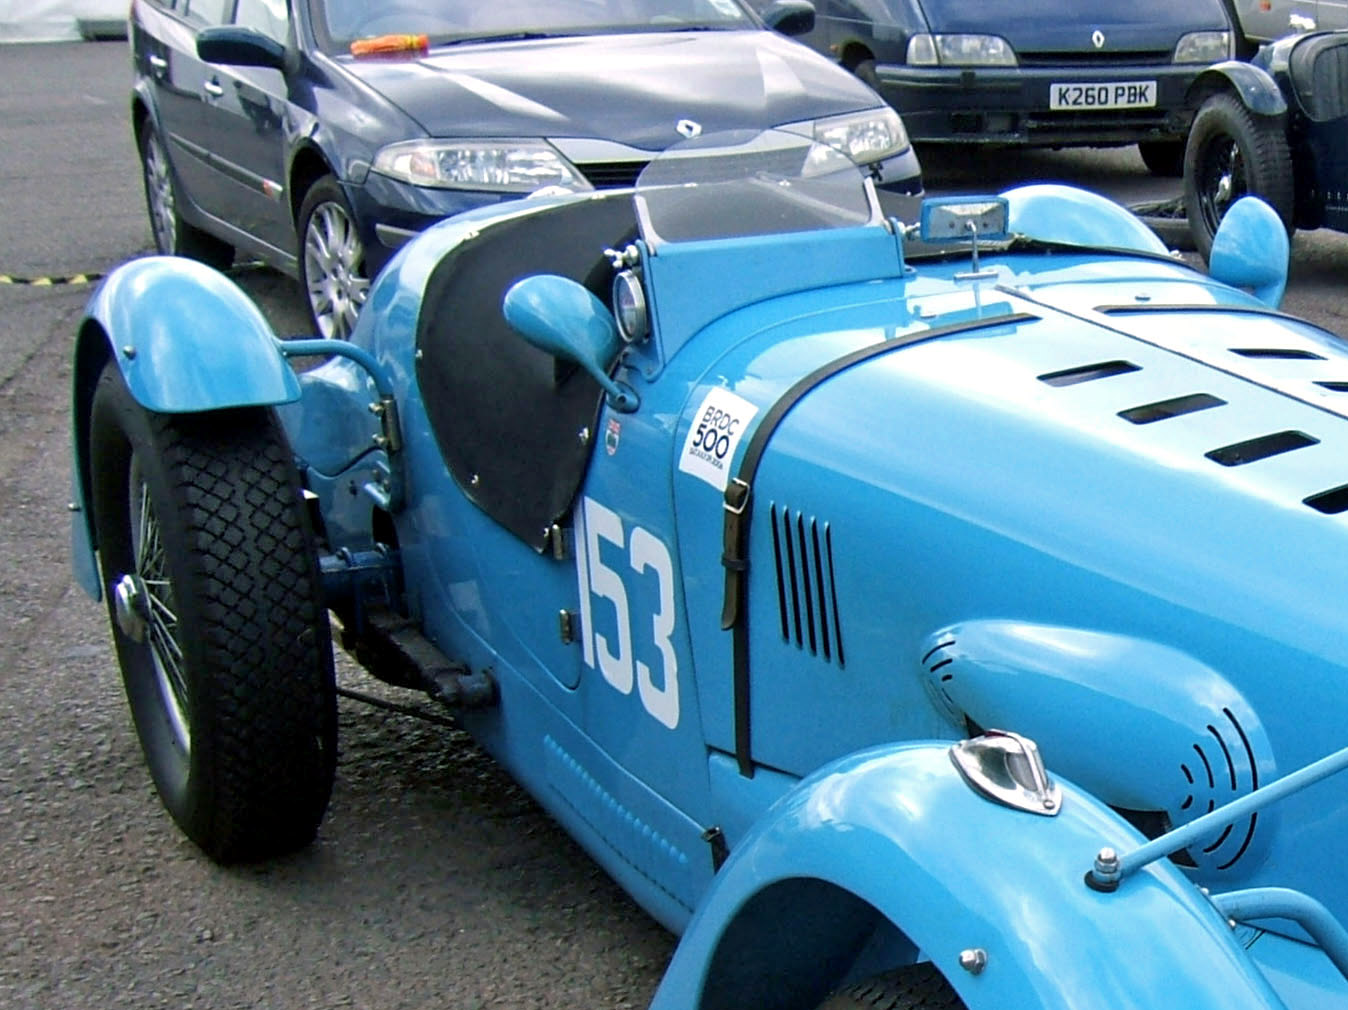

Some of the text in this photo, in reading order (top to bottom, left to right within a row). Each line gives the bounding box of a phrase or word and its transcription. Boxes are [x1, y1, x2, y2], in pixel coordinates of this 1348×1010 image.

[1058, 85, 1149, 106] K260 PBK
[702, 405, 740, 436] BRDC
[692, 424, 729, 460] 500
[573, 495, 680, 730] 153
